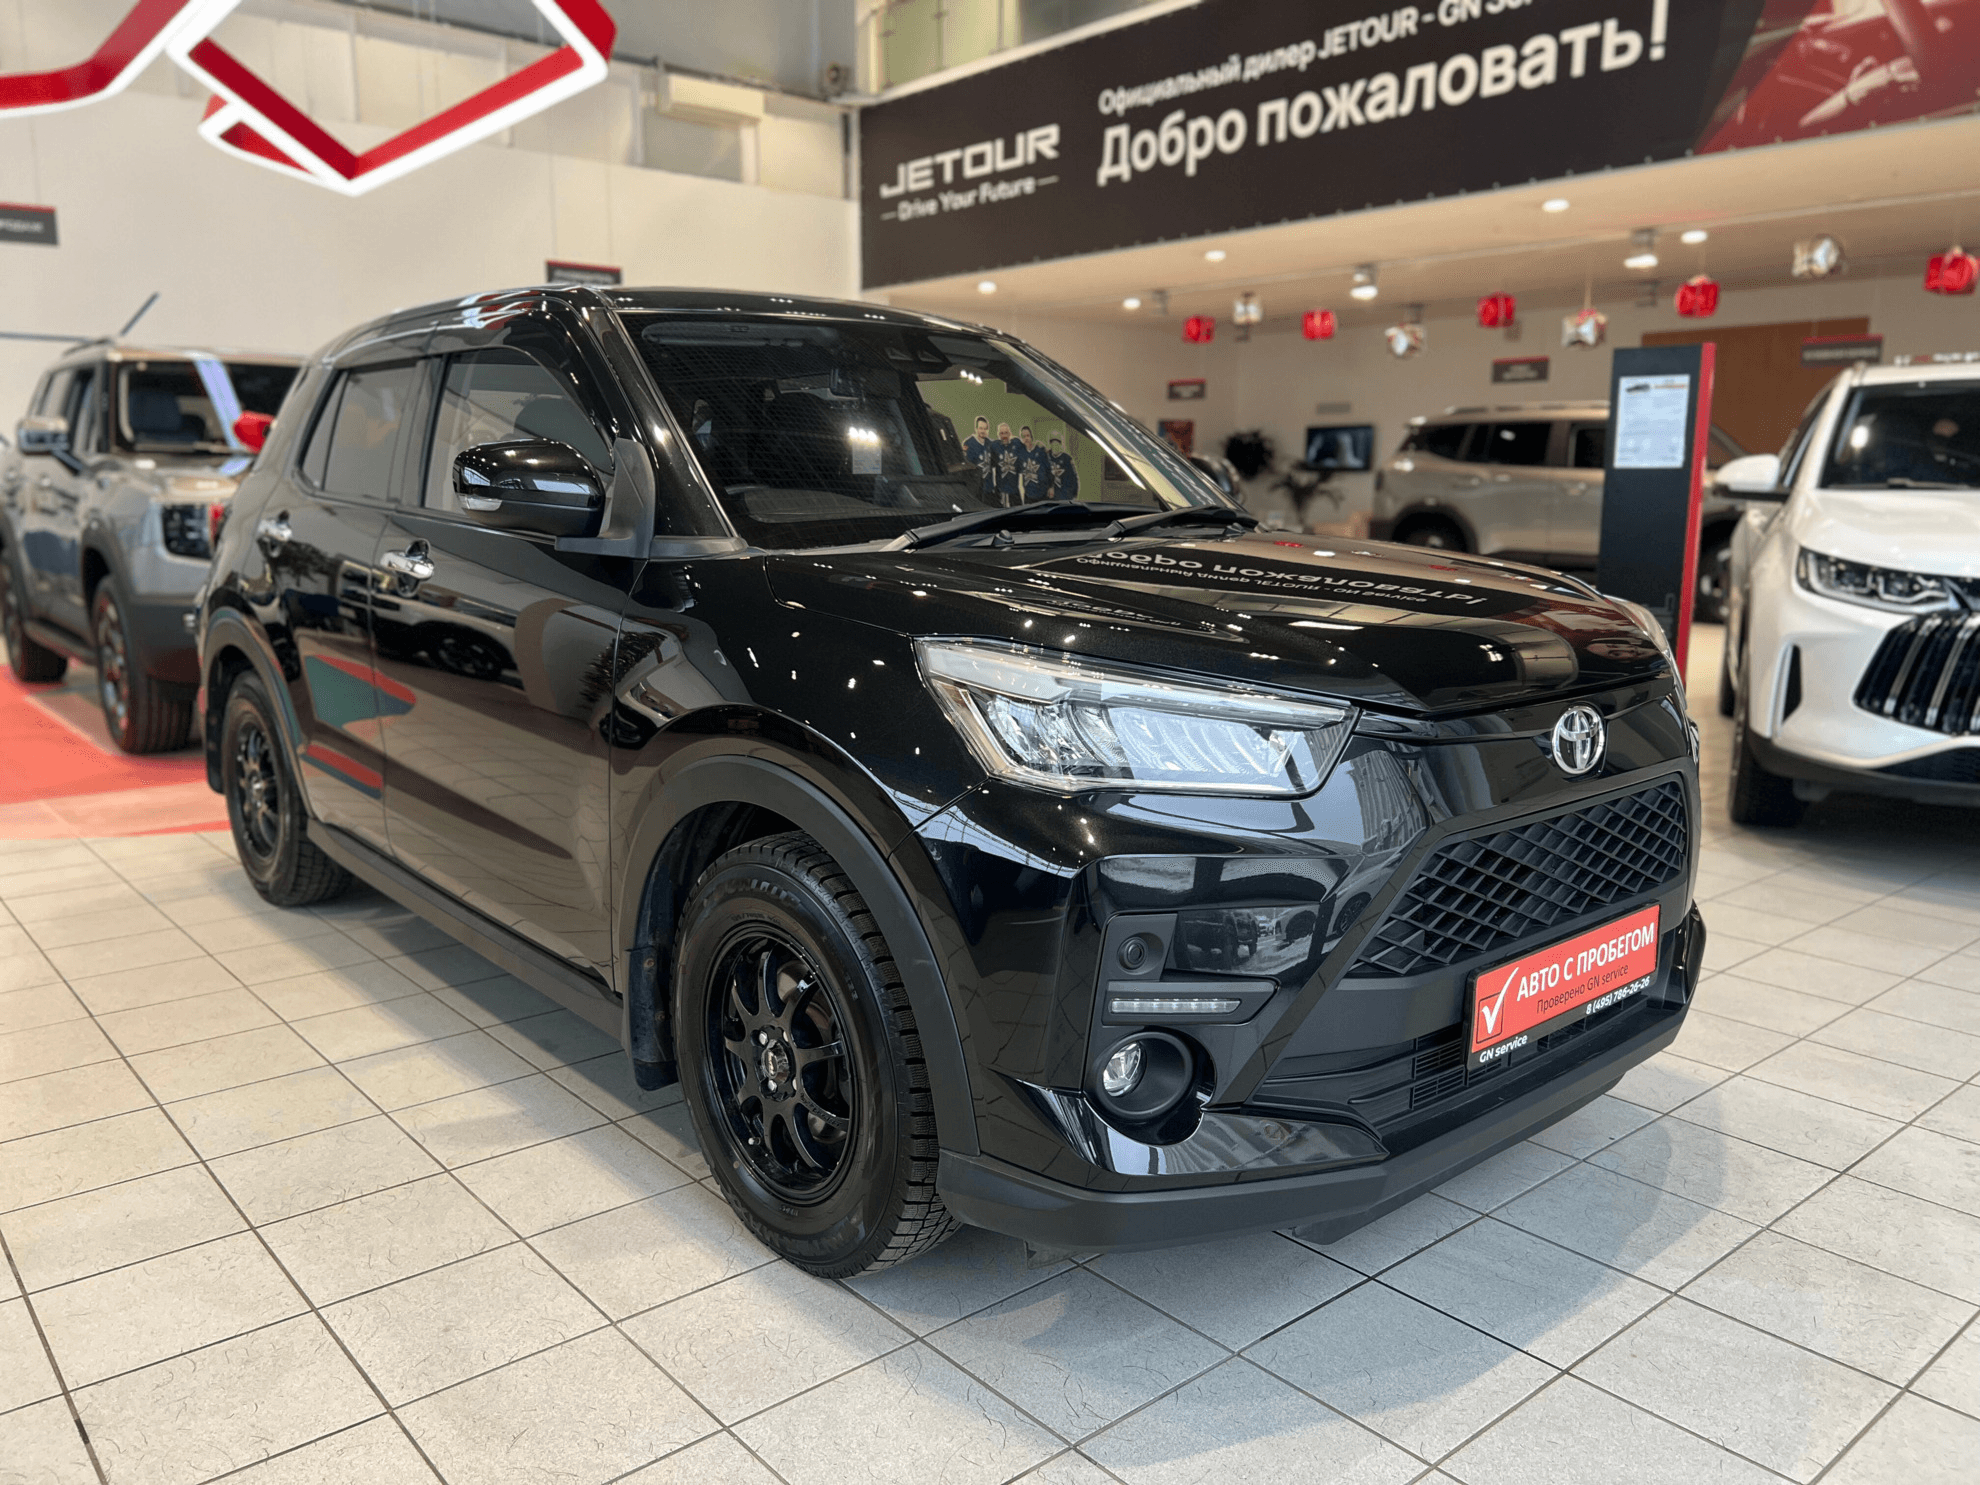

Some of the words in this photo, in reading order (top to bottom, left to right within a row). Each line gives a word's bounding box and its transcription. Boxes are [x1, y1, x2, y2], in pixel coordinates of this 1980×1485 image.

[1099, 53, 1241, 117] Официальный
[1242, 39, 1317, 84] дилер
[1317, 5, 1420, 59] JETOUR
[1097, 107, 1247, 187] Добро
[1256, 0, 1669, 146] пожаловать!
[879, 122, 1061, 199] JETOUR
[898, 198, 939, 222] Drive
[938, 189, 978, 212] Your
[978, 176, 1037, 204] Future
[1516, 963, 1560, 1002] АВТО
[1563, 957, 1574, 982] С
[1576, 922, 1655, 976] ПРОБЕГОМ
[1536, 985, 1585, 1015] Проверено
[1587, 975, 1600, 992] GN
[1601, 964, 1629, 986] service
[1585, 1002, 1592, 1015] 8
[1592, 993, 1613, 1013] (495)
[1479, 1048, 1494, 1063] GN
[1494, 1035, 1528, 1058] service
